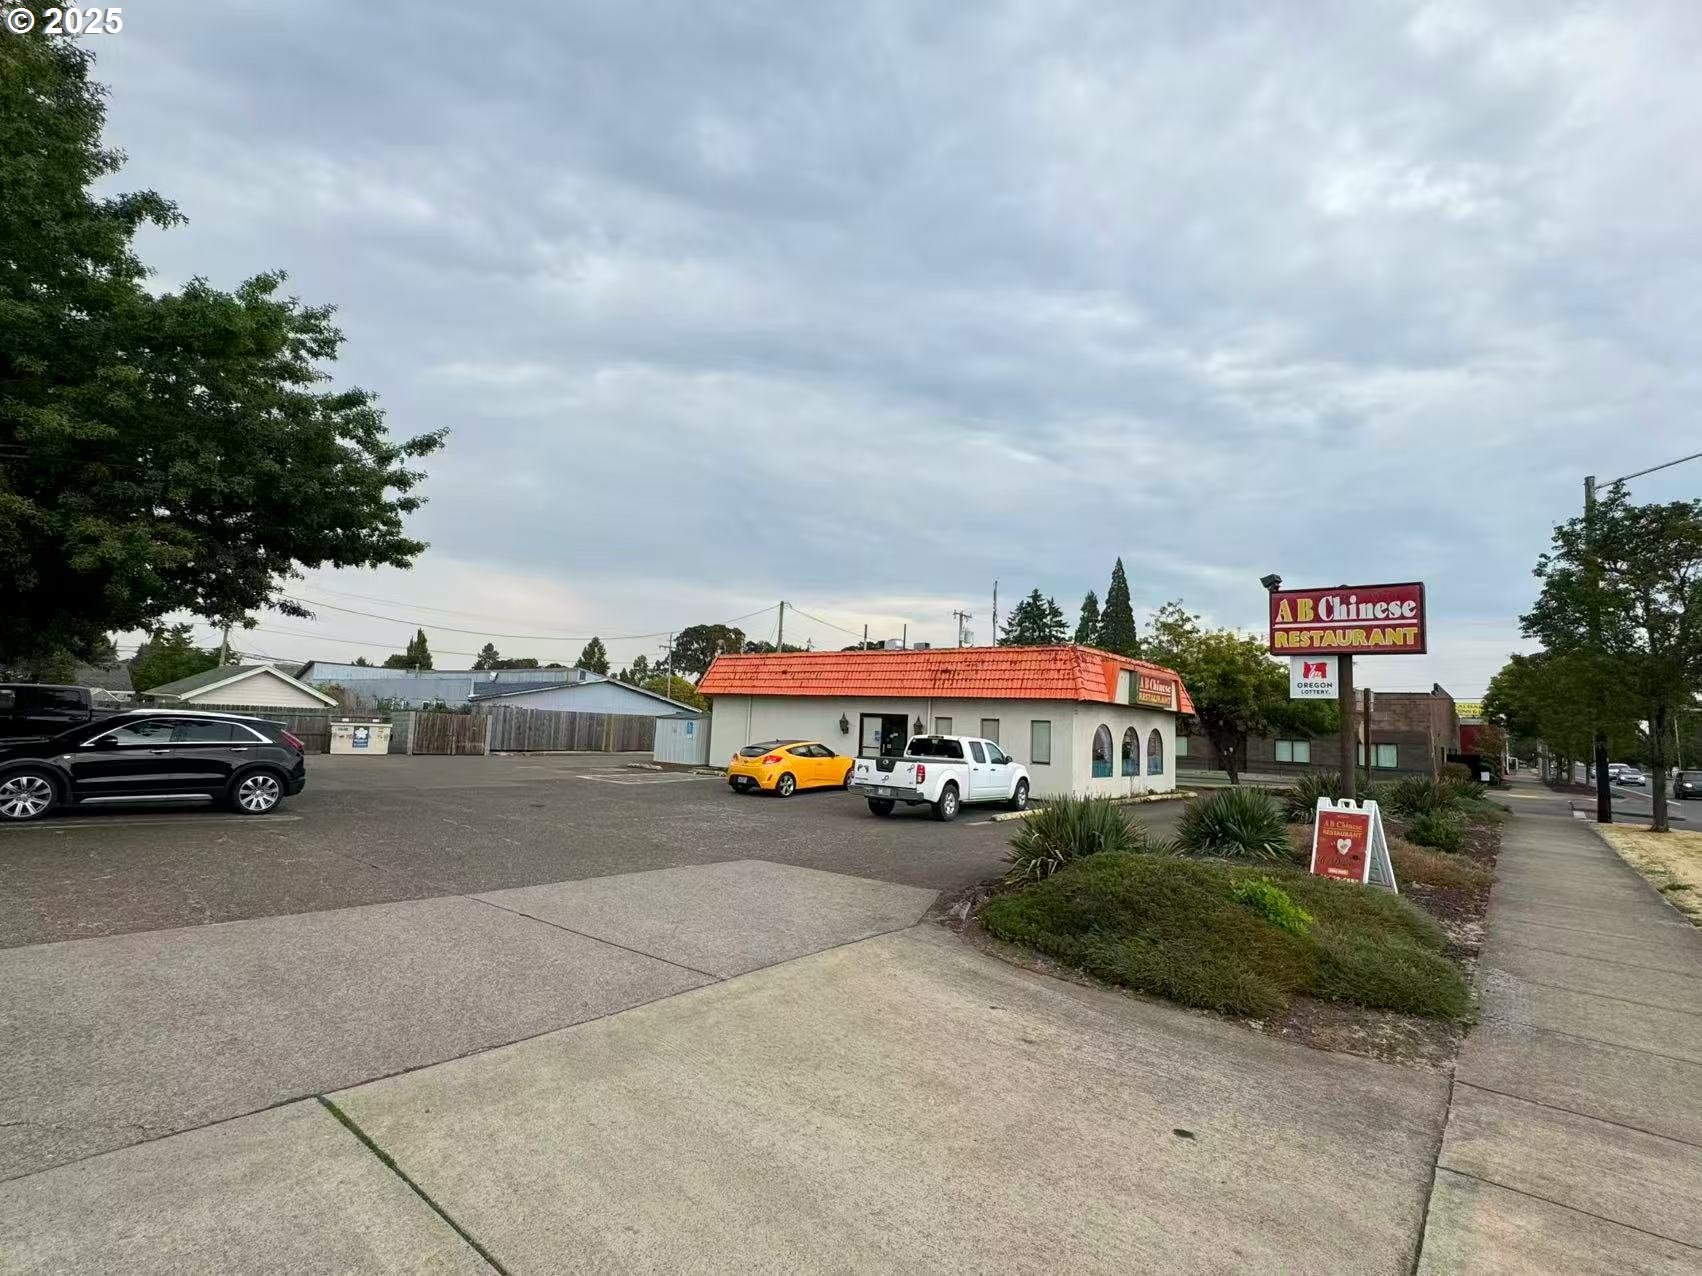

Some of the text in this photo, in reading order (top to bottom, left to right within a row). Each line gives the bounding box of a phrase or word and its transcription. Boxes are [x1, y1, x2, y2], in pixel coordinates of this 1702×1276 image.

[1275, 595, 1417, 623] A B Chinese
[1274, 627, 1418, 648] RESTAURANT
[1150, 678, 1171, 693] Chinese
[1337, 821, 1363, 830] Chinese
[1322, 829, 1363, 838] RESTAURANT
